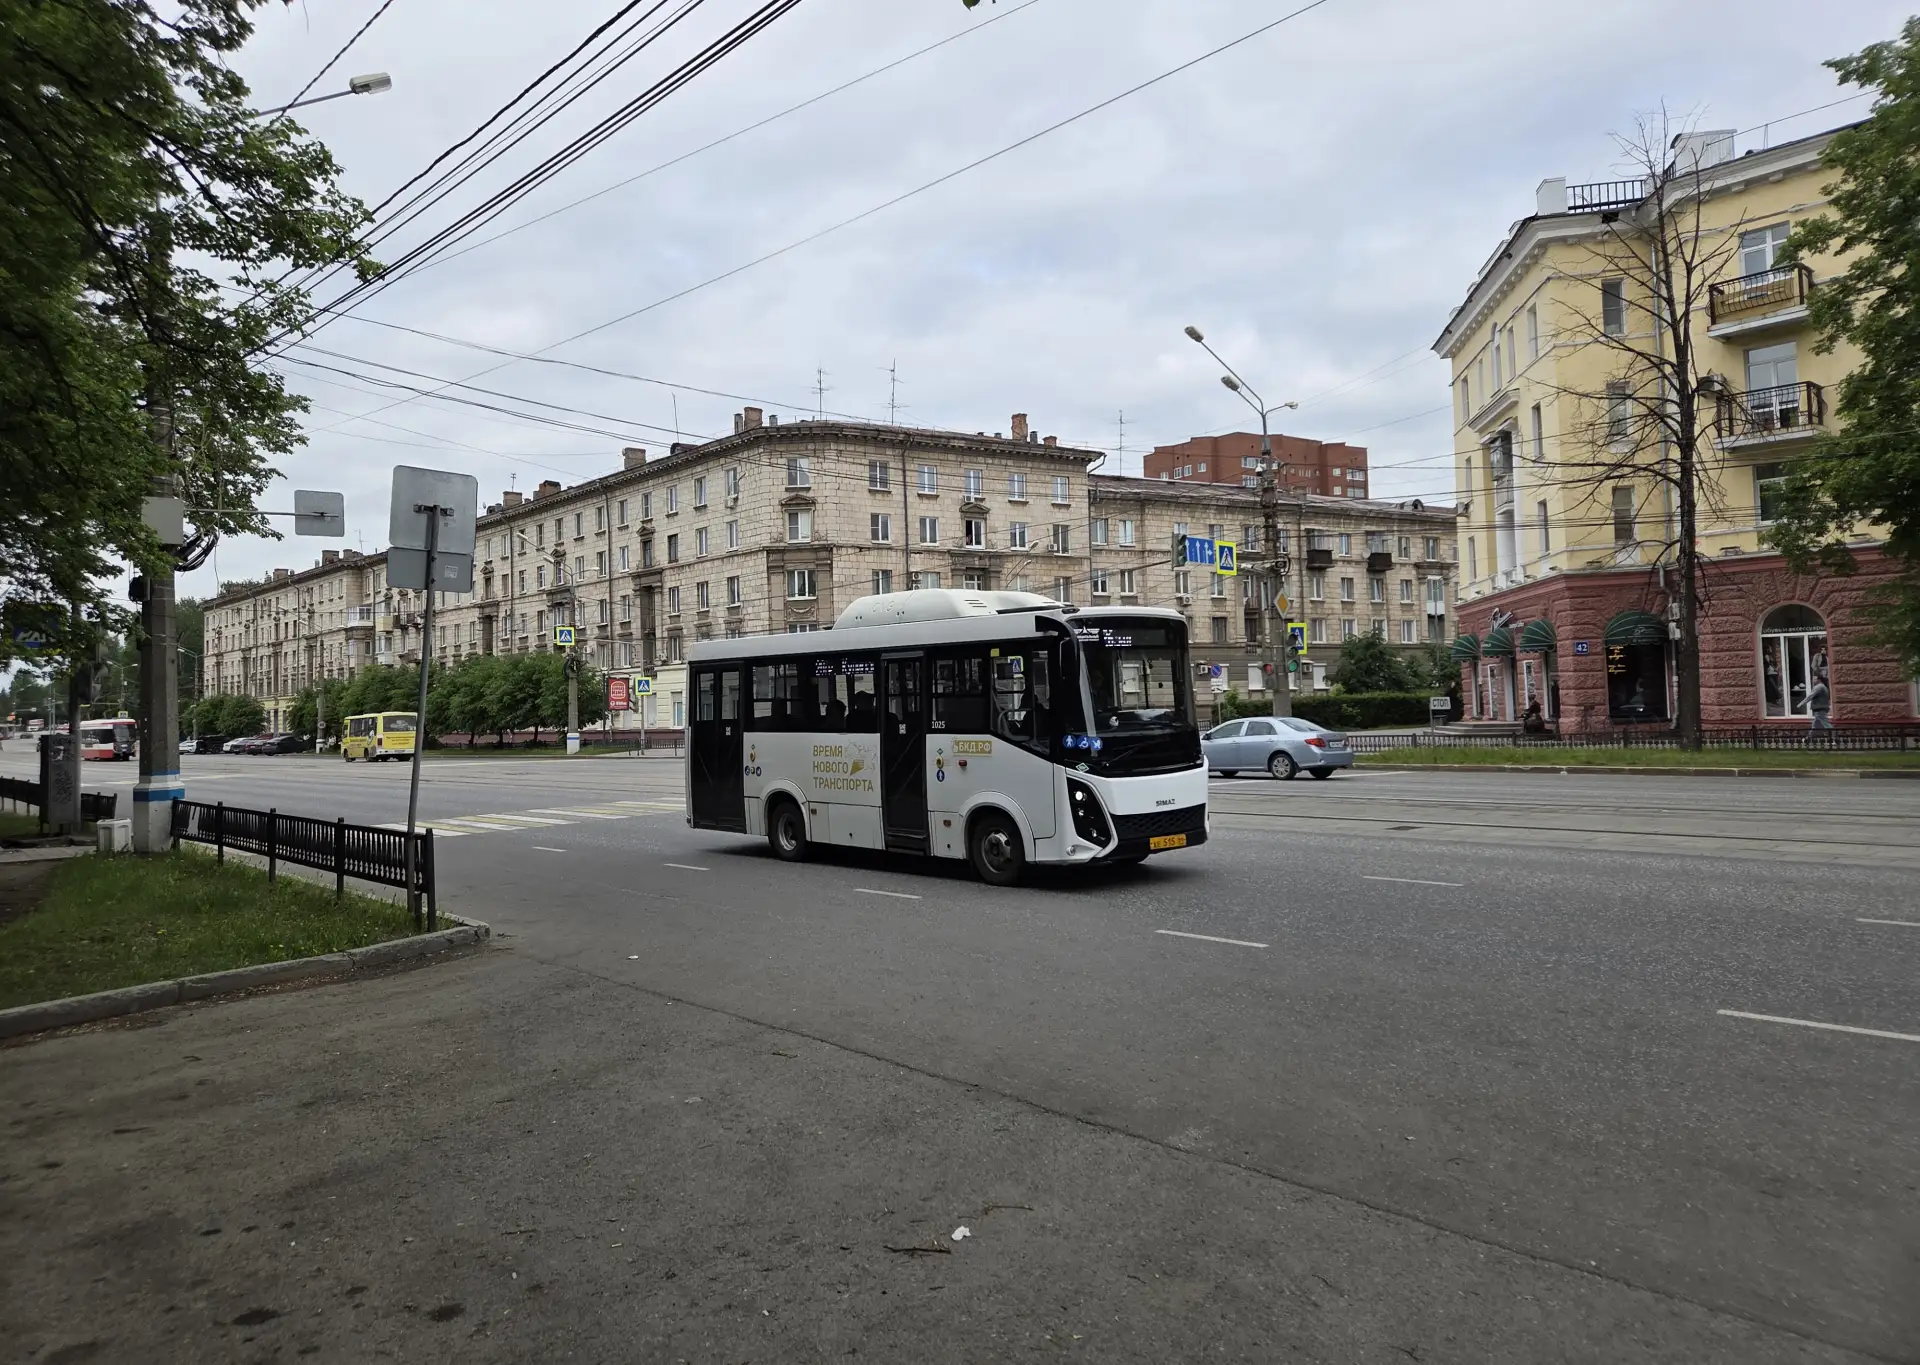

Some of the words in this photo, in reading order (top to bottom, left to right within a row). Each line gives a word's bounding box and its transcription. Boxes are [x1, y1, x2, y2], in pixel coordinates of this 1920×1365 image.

[1576, 643, 1588, 652] 42
[1432, 698, 1449, 708] СТОП
[931, 720, 946, 729] 1025
[813, 744, 843, 758] ВРЕМЯ
[958, 741, 991, 752] БКД.РФ
[812, 760, 849, 774] НОВОГО
[813, 776, 874, 792] ТРАНСПОРТА
